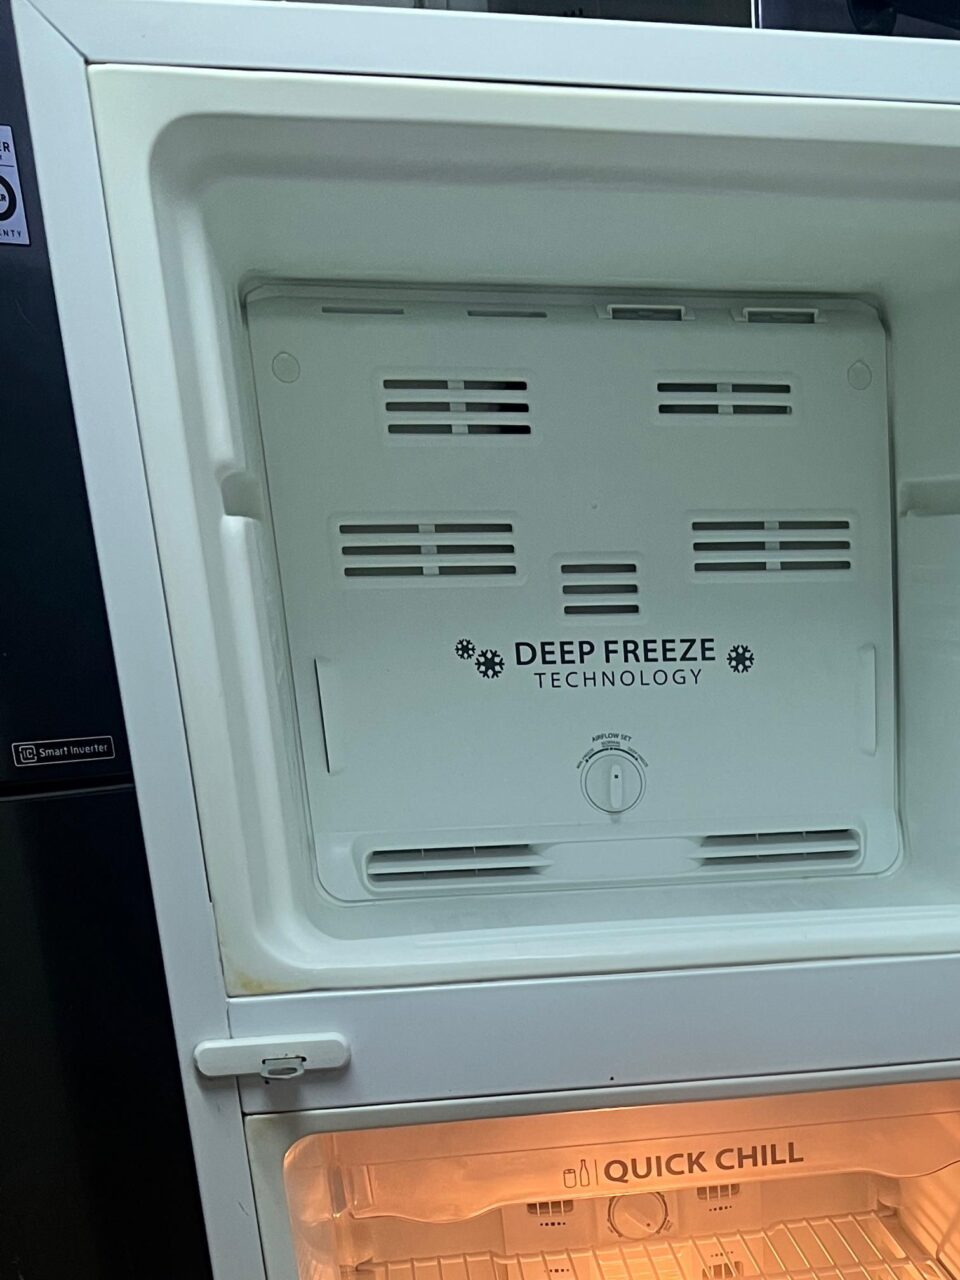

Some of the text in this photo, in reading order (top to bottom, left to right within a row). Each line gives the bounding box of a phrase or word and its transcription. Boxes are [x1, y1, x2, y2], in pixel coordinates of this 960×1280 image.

[514, 638, 717, 666] DEEP FREEZE
[533, 668, 703, 689] TECHNOLOGY
[39, 746, 68, 757] Smart
[70, 744, 108, 755] Inverter
[603, 1142, 804, 1184] QUICK CHILL
